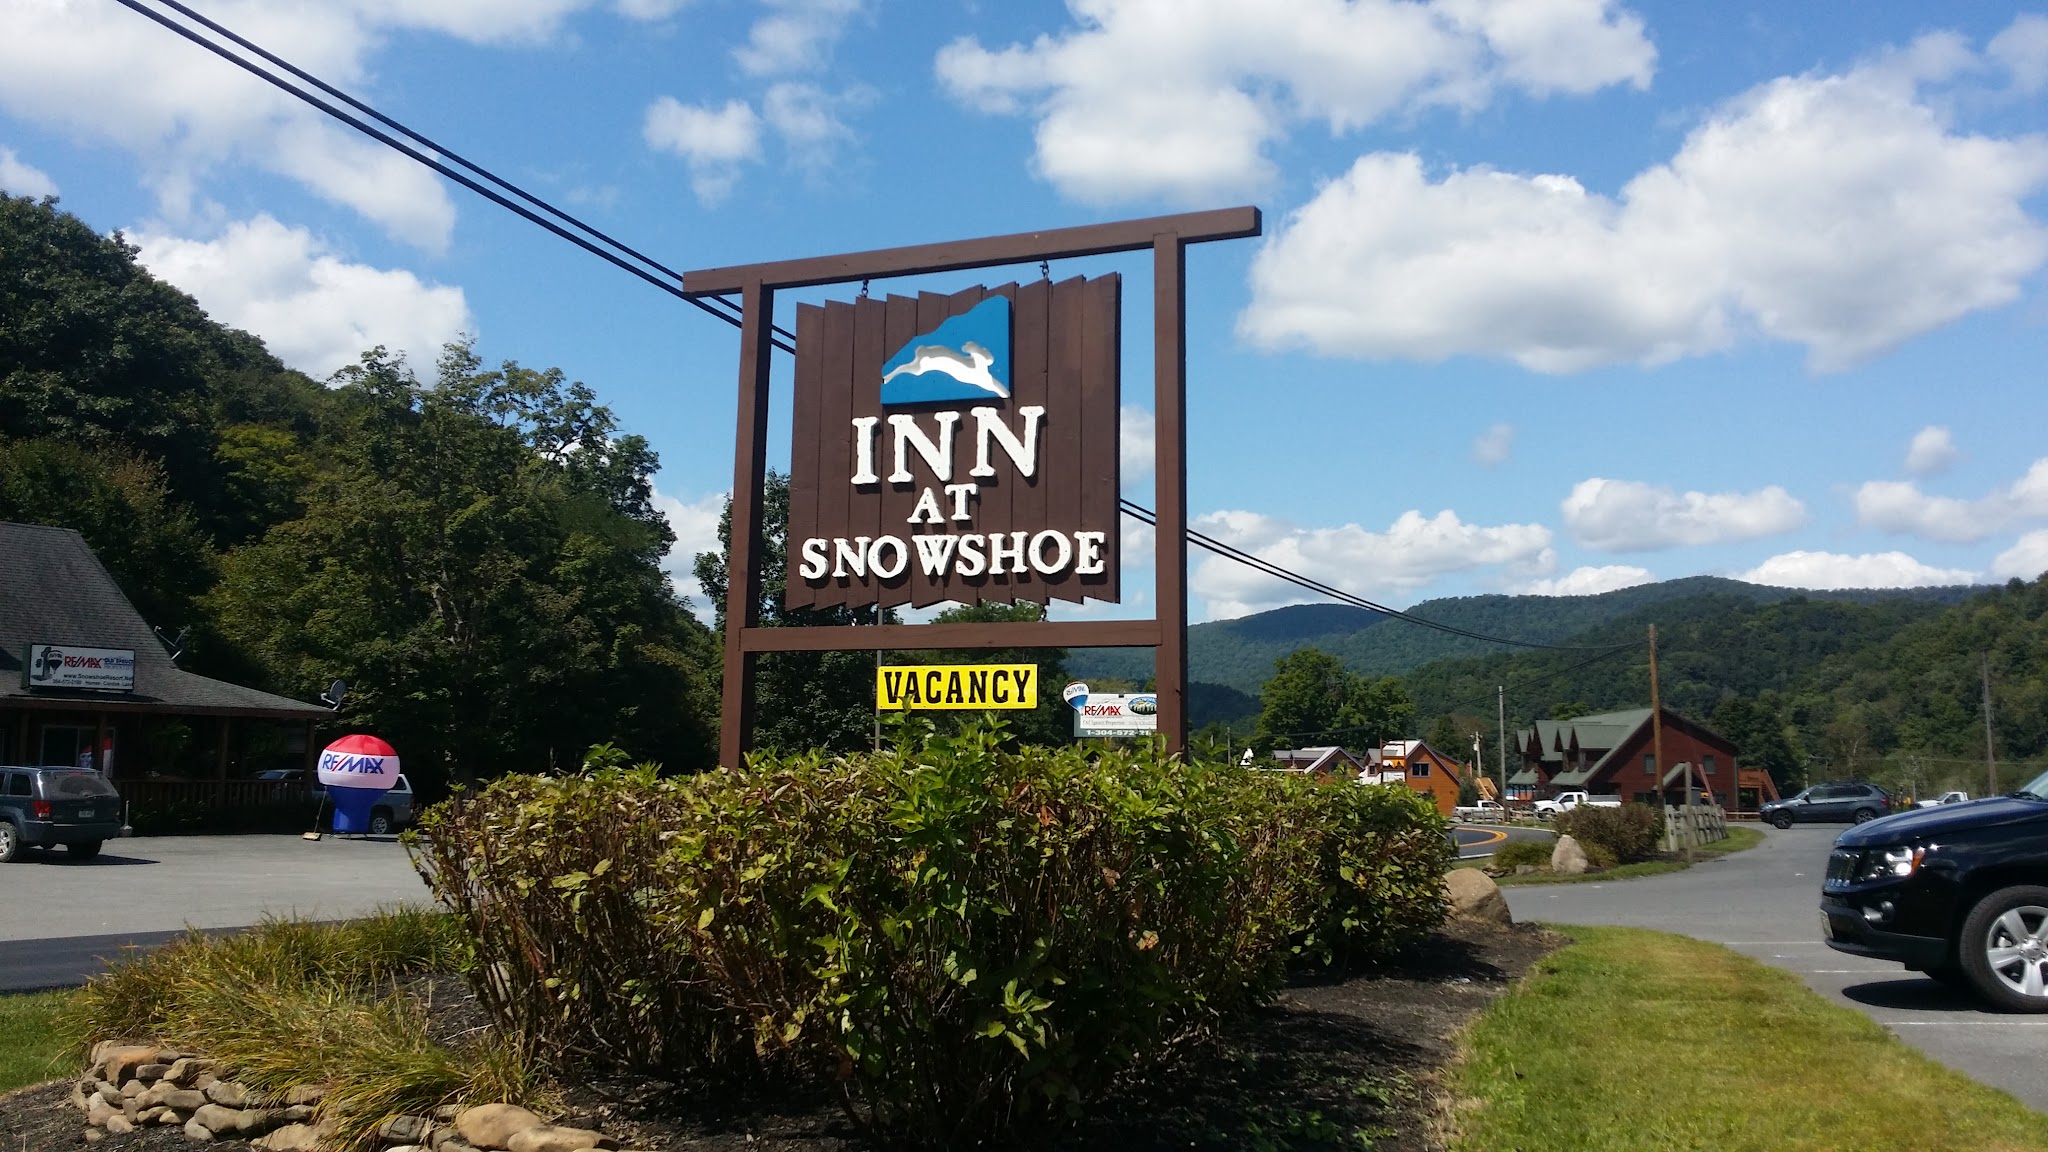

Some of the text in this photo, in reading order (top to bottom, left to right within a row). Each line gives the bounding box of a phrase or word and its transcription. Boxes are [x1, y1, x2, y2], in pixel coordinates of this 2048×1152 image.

[850, 404, 1047, 485] INN
[906, 482, 978, 524] AT
[799, 529, 1105, 580] SNOWSHOE
[65, 656, 102, 668] RE/MAX
[884, 670, 1031, 704] VACANCY
[1084, 705, 1121, 716] RE/MAX
[322, 753, 384, 775] RE/MAX
